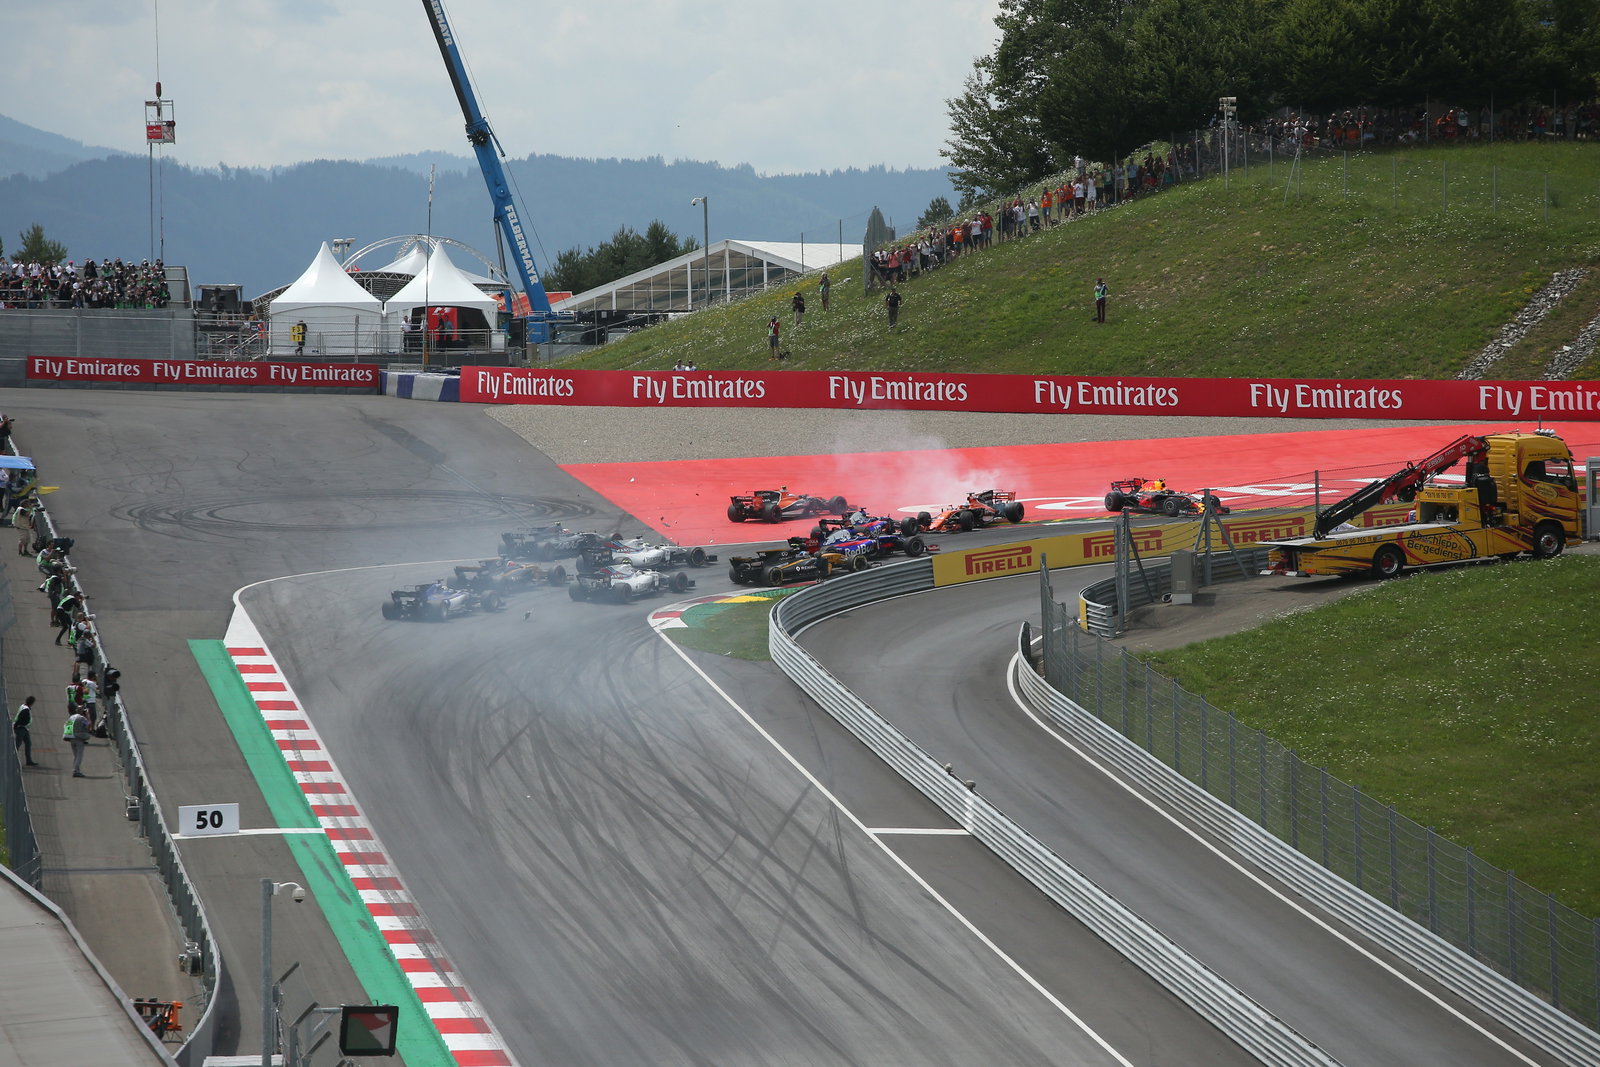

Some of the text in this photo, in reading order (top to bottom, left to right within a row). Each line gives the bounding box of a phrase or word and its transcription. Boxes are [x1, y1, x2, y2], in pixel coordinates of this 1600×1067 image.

[430, 0, 452, 46] ERMAYR
[504, 205, 539, 286] FELBERMAYR
[34, 358, 140, 377] Fly Emirates
[153, 361, 258, 380] Fly Emirates
[270, 364, 373, 383] Fly Emirates
[478, 370, 574, 398] Fly Emirates
[633, 374, 766, 403] Fly Emirates
[828, 376, 968, 404] Fly Emirates
[1034, 379, 1179, 409] Fly Emirates
[1250, 382, 1403, 412] Fly Emirates
[1479, 385, 1600, 416] Fly Emir
[1083, 530, 1162, 558] PIRLLI
[1221, 517, 1305, 544] PIRELLI
[965, 546, 1032, 575] PIRELLI
[1407, 540, 1463, 559] Bergedienst
[197, 811, 223, 829] 50
